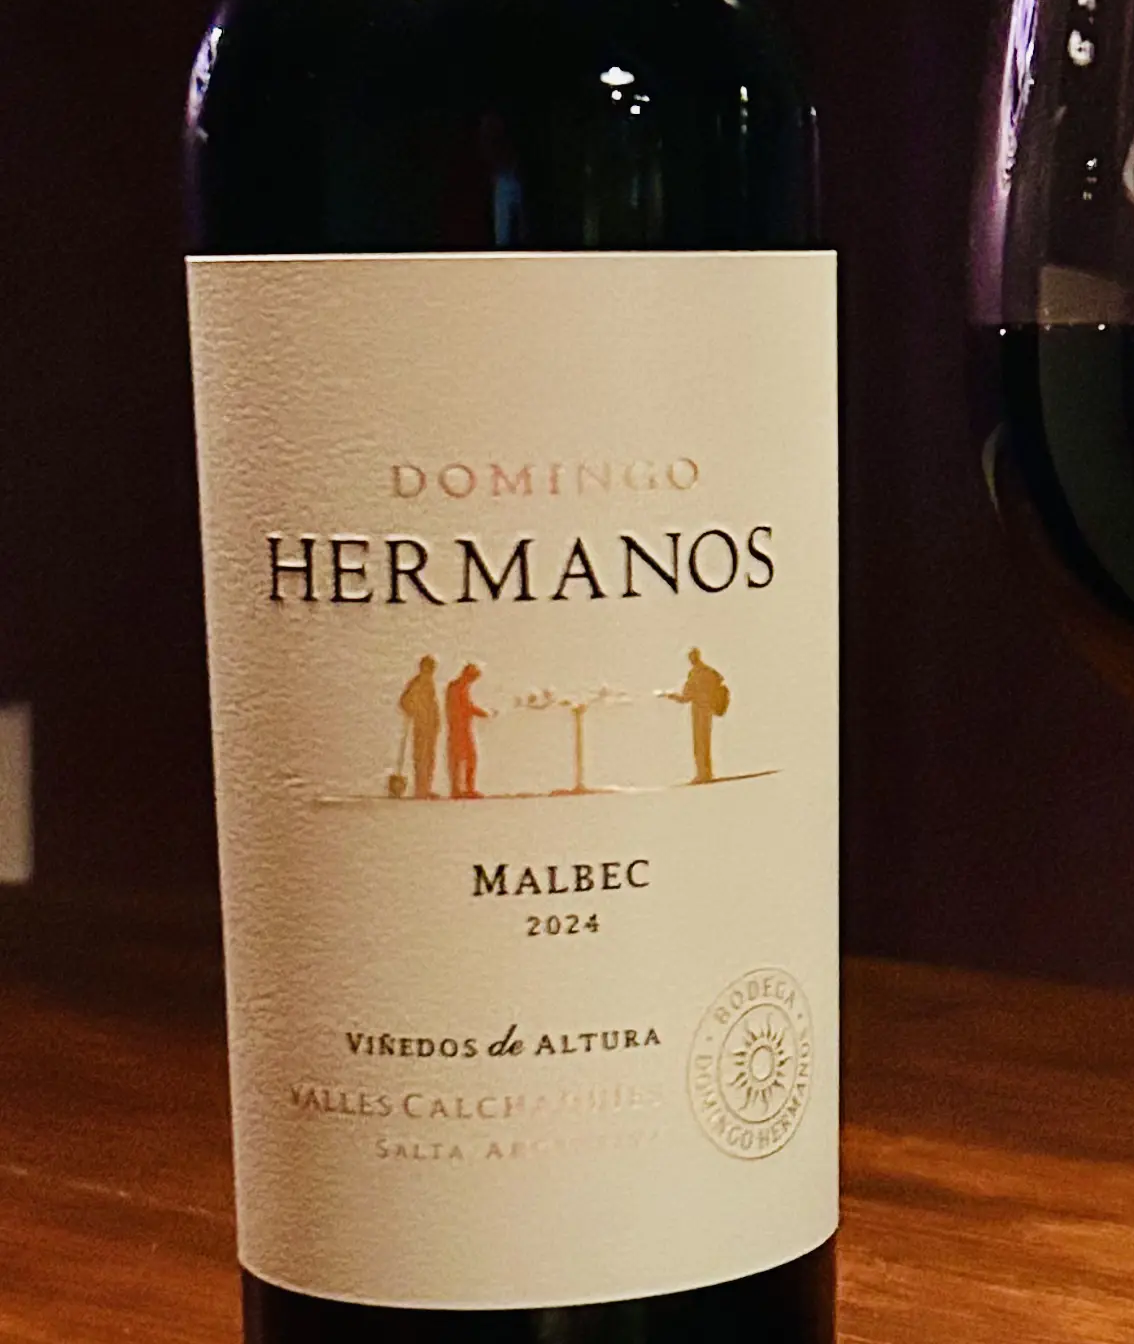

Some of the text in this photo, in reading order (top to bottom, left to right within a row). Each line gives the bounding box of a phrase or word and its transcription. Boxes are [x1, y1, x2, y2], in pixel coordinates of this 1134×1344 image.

[390, 458, 699, 500] DOMINGO
[267, 526, 775, 605] HERMANOS
[472, 859, 651, 897] MALBEC
[525, 914, 601, 937] 2024
[714, 976, 796, 1027] BODEGA
[345, 1022, 661, 1058] VIÑEDOS de ALTURA
